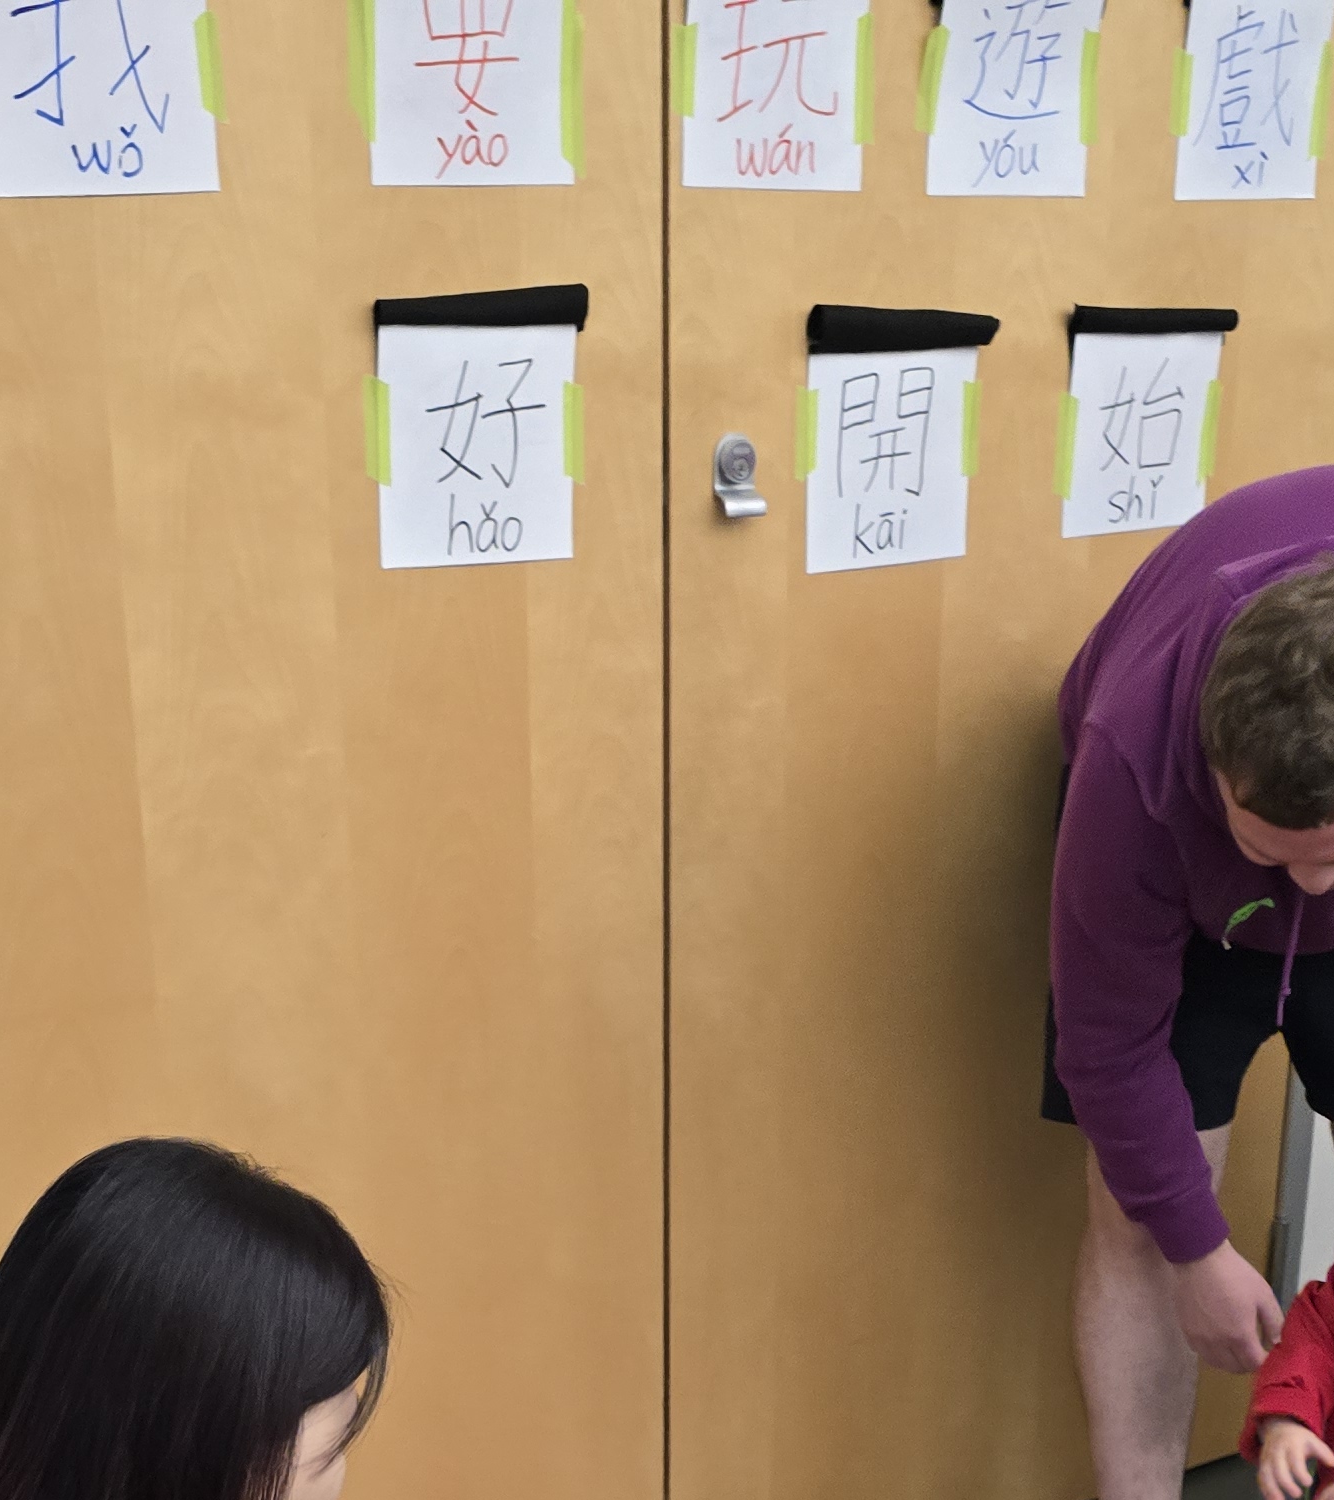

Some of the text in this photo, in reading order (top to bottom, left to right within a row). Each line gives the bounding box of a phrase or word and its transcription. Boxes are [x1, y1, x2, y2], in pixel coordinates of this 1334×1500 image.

[717, 0, 839, 122] 玩
[1192, 4, 1300, 150] 戲
[71, 124, 144, 177] wǒ
[437, 120, 509, 180] yào
[736, 123, 816, 178] wán
[972, 129, 1040, 188] yóu
[425, 359, 546, 488] 好
[838, 366, 936, 499] 開
[1098, 357, 1185, 472] 始
[447, 492, 523, 556] hǎo
